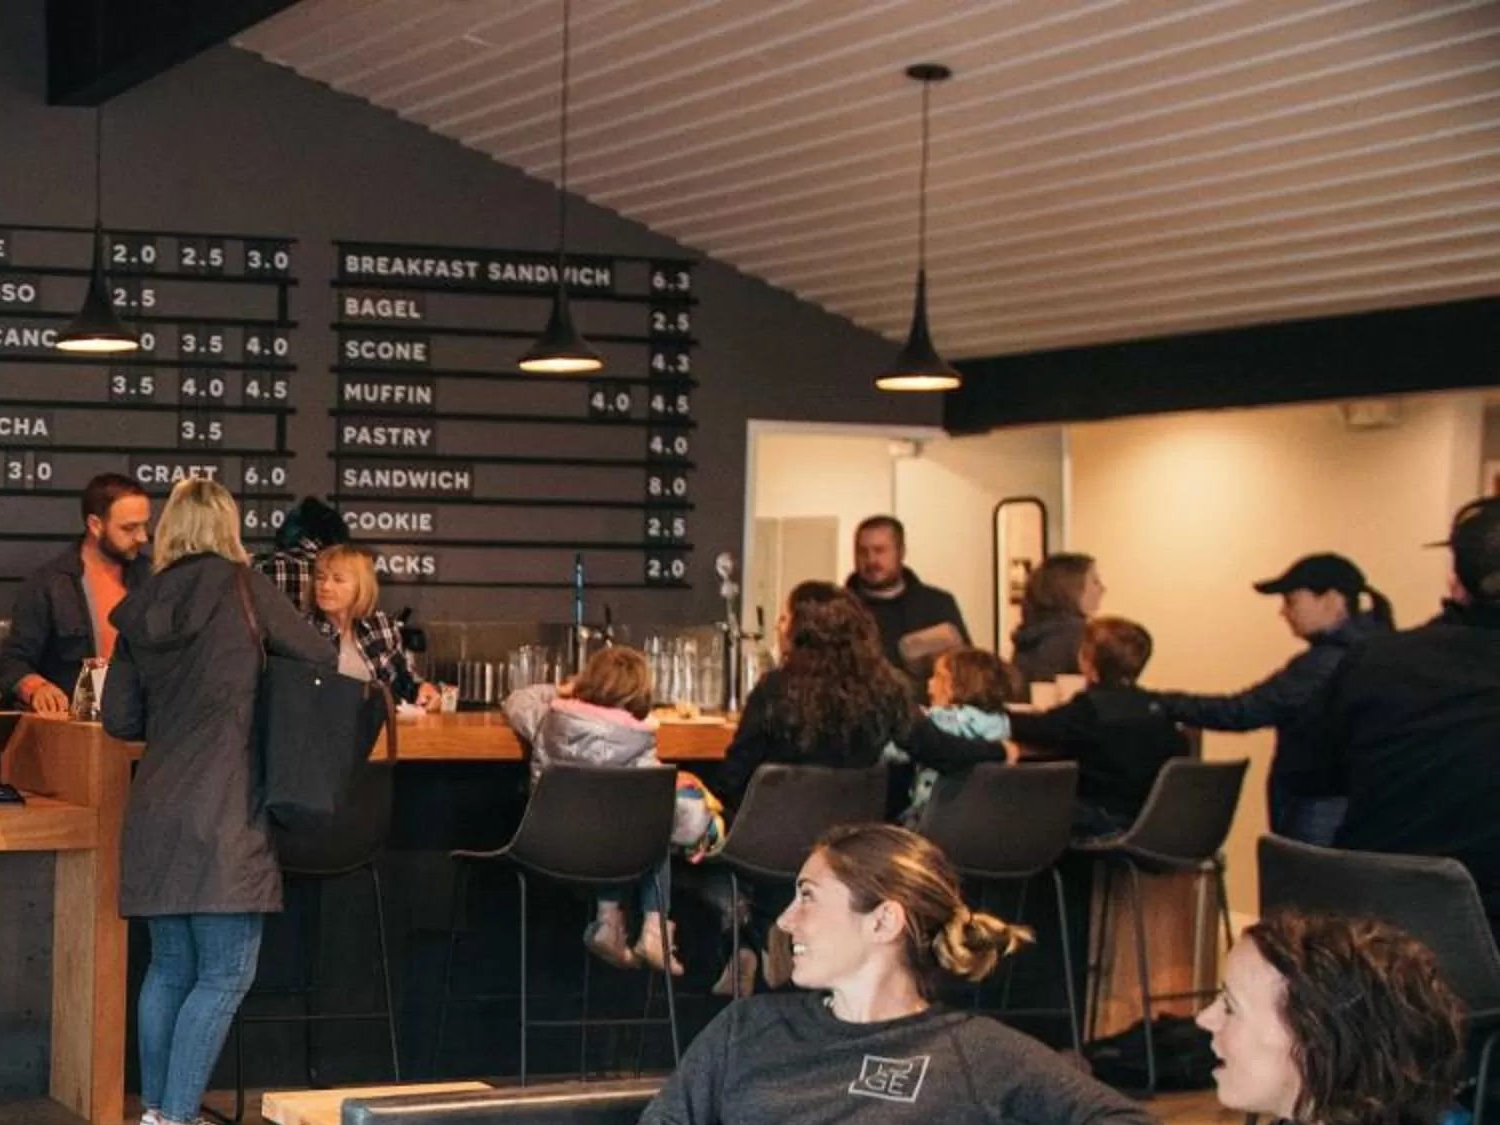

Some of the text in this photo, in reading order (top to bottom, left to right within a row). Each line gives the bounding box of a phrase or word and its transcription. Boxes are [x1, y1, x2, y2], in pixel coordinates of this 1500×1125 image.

[113, 244, 156, 264] 2.0
[182, 247, 223, 267] 2.5
[248, 250, 289, 270] 3.0
[345, 255, 478, 279] BREAKFAST
[113, 287, 156, 308] 2.5
[345, 297, 690, 332] BAGEL 2.5
[182, 333, 223, 353] 3.5
[246, 336, 289, 356] 4.0
[345, 340, 425, 361] SCONE
[112, 375, 154, 395] 3.5
[181, 378, 224, 397] 4.0
[245, 380, 287, 399] 4.5
[344, 383, 690, 414] MUFFIN 4.0 4.5
[182, 420, 223, 441] 3.5
[343, 425, 688, 455] PASTRY 4.0
[8, 461, 52, 481] 3.0
[136, 464, 218, 482] CRAFT
[244, 467, 286, 486] 6.0
[344, 468, 687, 497] SANDWICH 8.0
[244, 509, 285, 529] 6.0
[343, 511, 686, 537] COOKIE 2.5
[375, 555, 685, 578] ACKS 2.0
